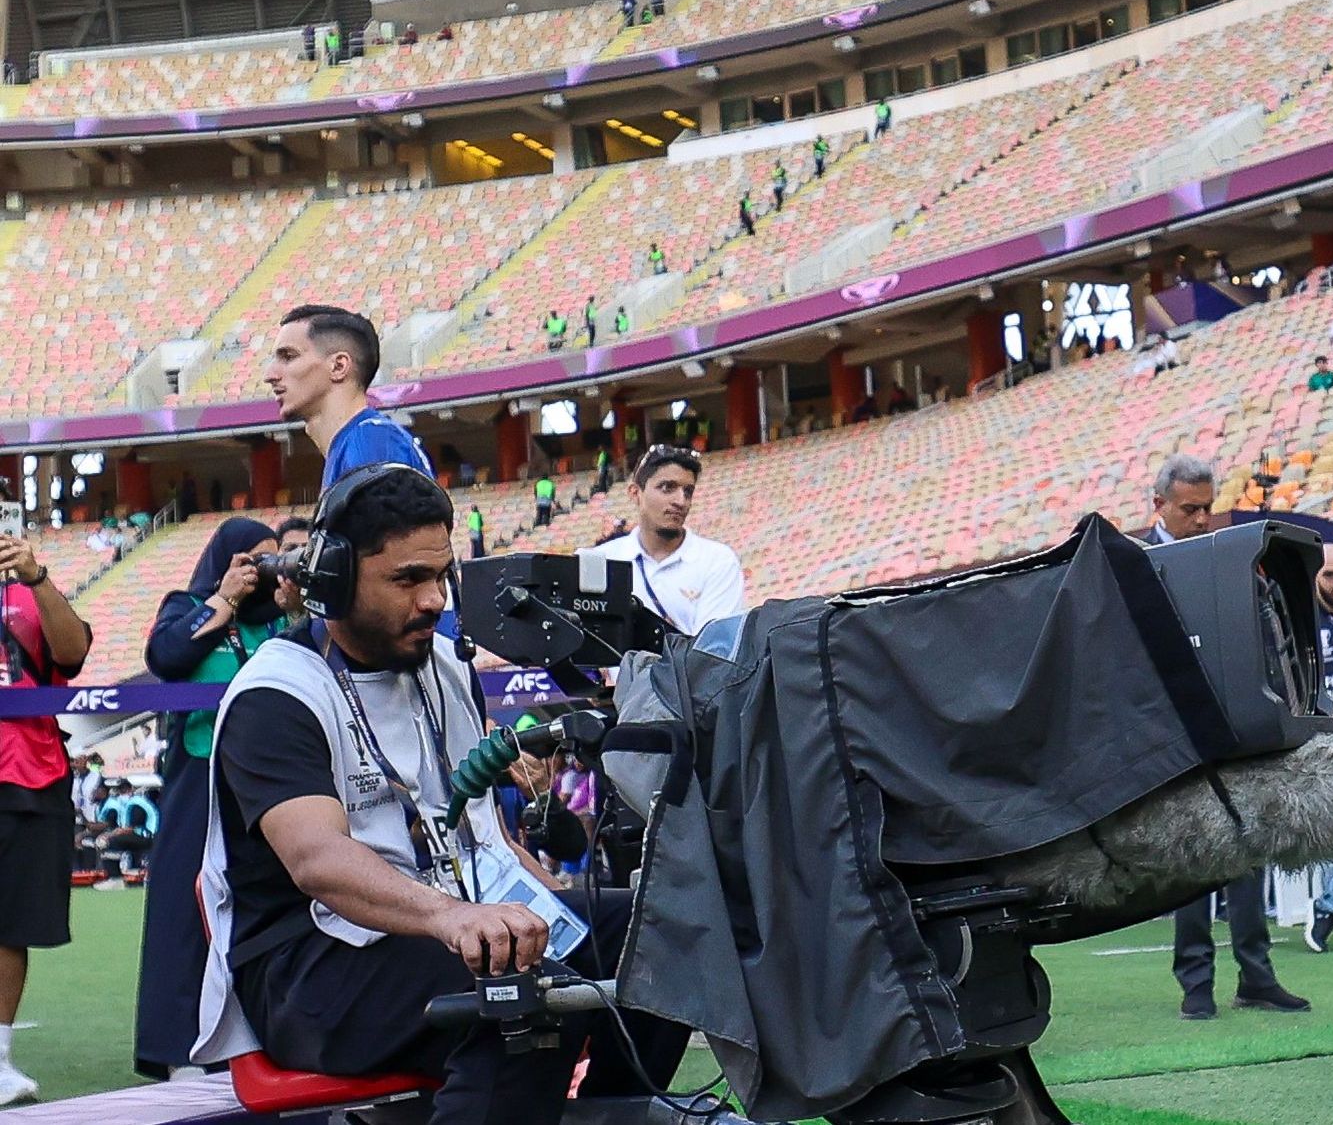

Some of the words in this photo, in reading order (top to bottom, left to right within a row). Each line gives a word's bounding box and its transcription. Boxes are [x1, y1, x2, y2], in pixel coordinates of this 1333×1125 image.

[573, 598, 608, 612] SONY
[504, 672, 551, 693] AFC
[65, 688, 120, 711] AFC
